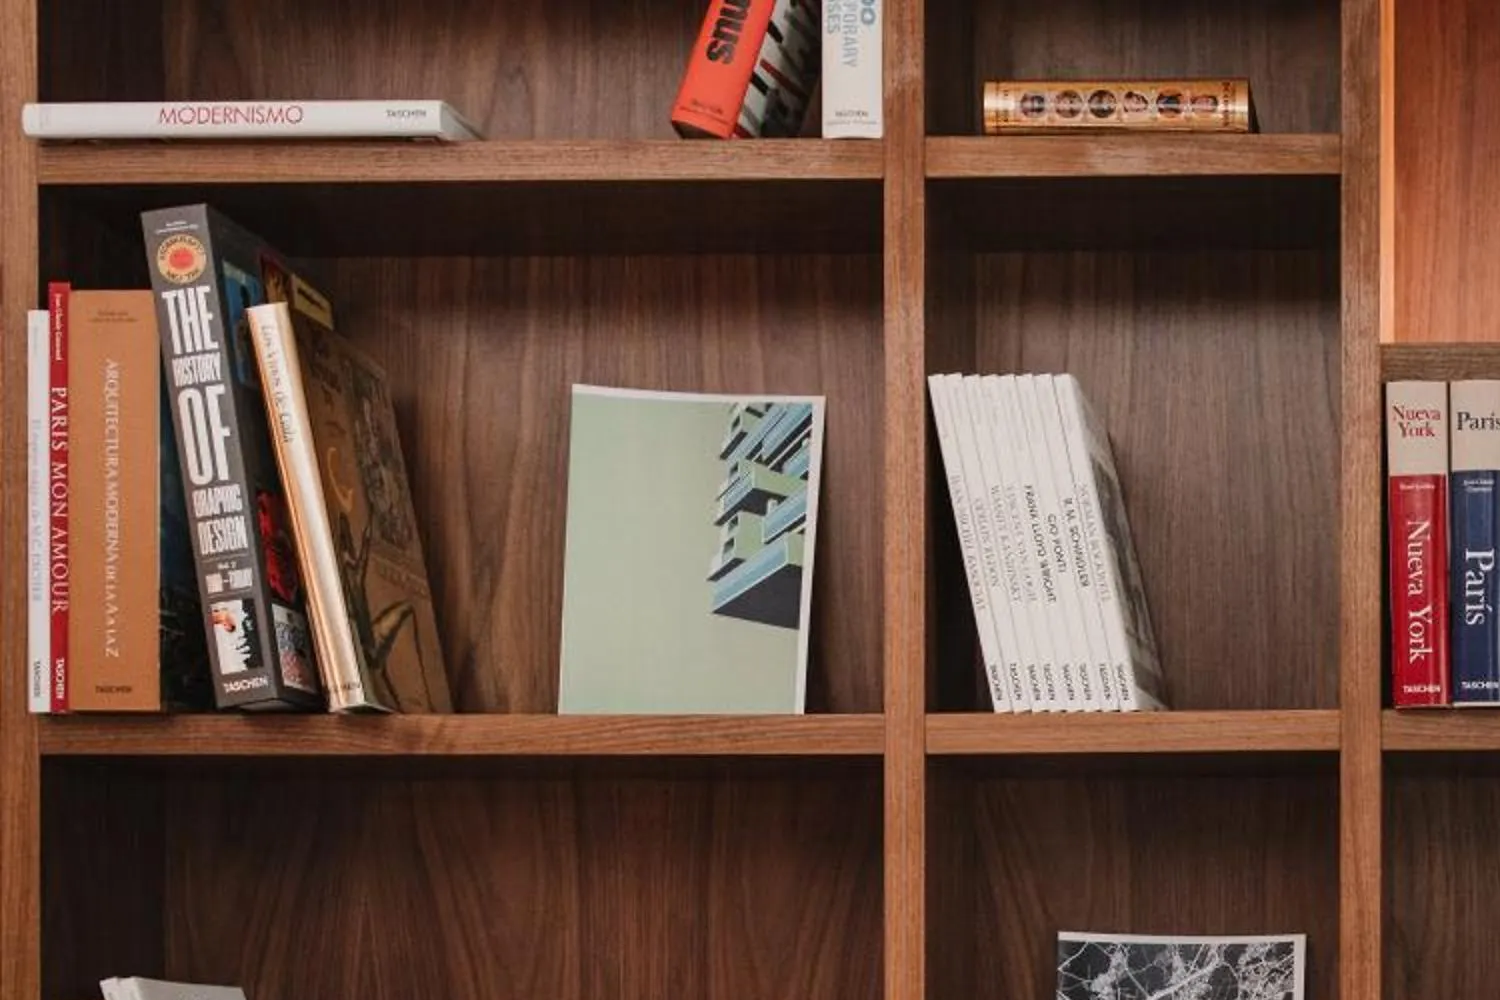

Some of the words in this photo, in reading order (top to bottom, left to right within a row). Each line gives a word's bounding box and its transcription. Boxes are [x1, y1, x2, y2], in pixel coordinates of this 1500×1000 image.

[827, 0, 842, 35] SES
[841, 0, 858, 68] PORARY
[157, 105, 304, 126] MODERNISMO
[386, 108, 428, 119] TASCHEN
[161, 285, 219, 355] THE
[171, 352, 221, 387] HISTORY
[51, 387, 68, 451] PARIS
[104, 359, 119, 480] ARQUITECTURA
[1393, 404, 1441, 421] Nueva
[1398, 421, 1436, 438] York
[177, 384, 230, 486] OF
[51, 463, 68, 518] MON
[192, 485, 243, 518] GRAPHIC
[104, 481, 119, 562] MODERNA
[197, 515, 248, 555] DESIGN
[1024, 485, 1038, 520] FRANK
[1032, 523, 1046, 557] LLOYD
[51, 527, 68, 615] AMOUR
[1053, 539, 1066, 573] PONTI
[1407, 520, 1431, 597] Nueva
[1465, 548, 1495, 625] París
[1408, 604, 1433, 664] York
[55, 658, 65, 700] TASCHEN
[222, 674, 270, 695] TASCHEN
[1403, 685, 1441, 694] TASCHEN
[1461, 681, 1500, 690] TASCHEN
